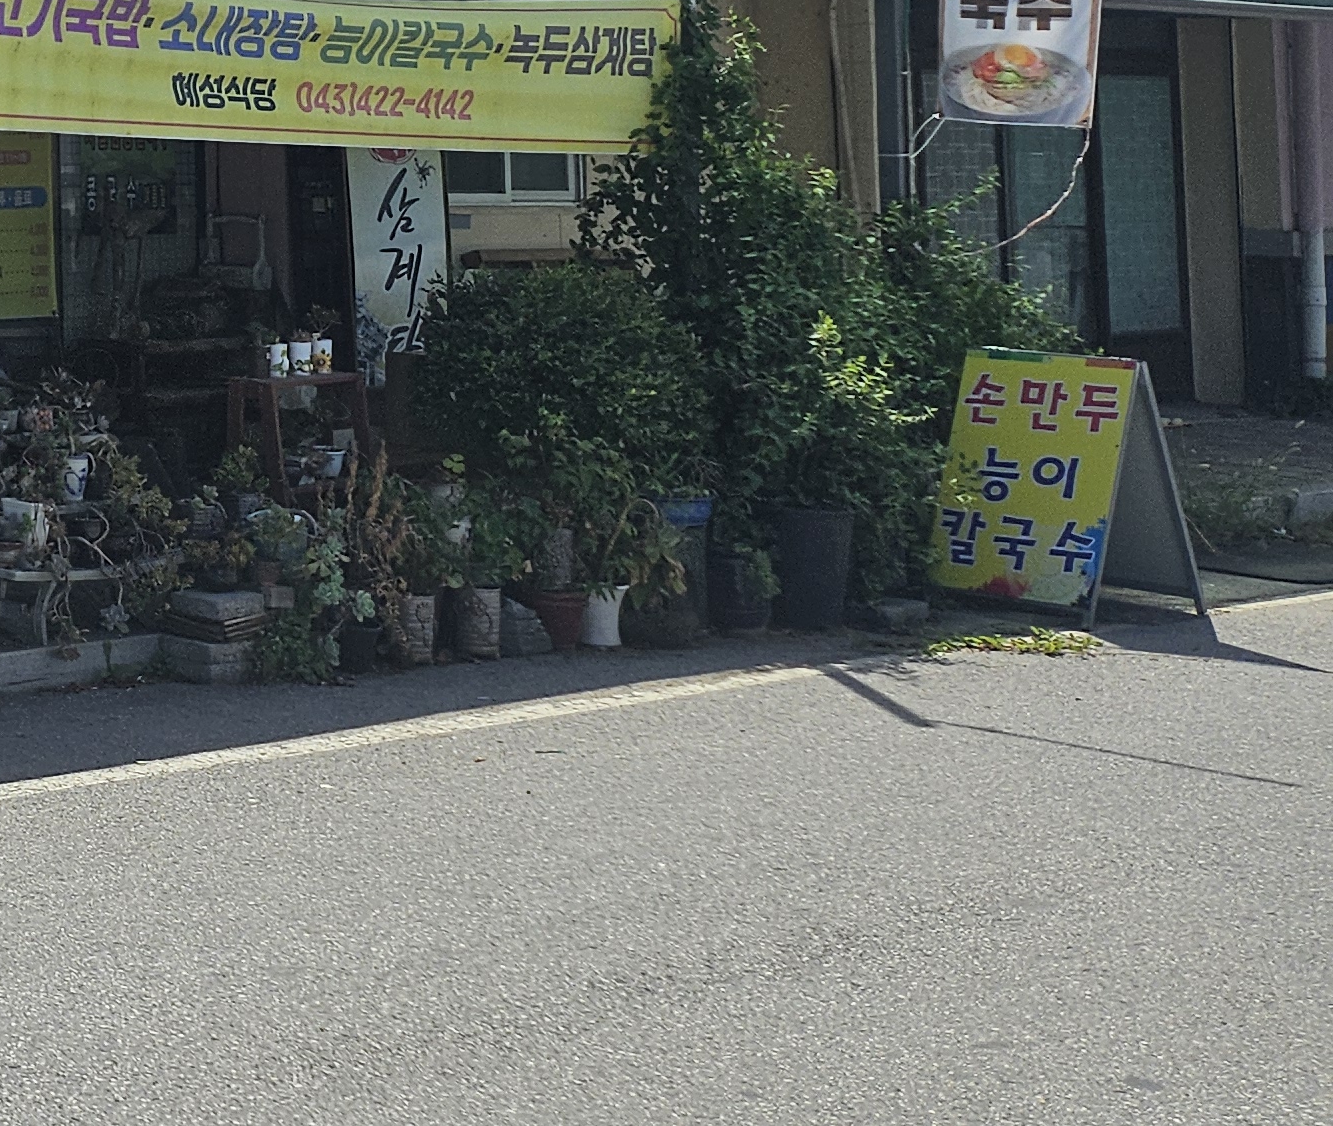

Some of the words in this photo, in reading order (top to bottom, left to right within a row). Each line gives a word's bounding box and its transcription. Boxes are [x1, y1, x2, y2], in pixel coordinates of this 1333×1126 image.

[172, 71, 277, 112] 혜성식당
[295, 81, 474, 121] 043)422-4142
[964, 373, 1119, 432] 손만두
[978, 447, 1079, 502] 능이
[940, 508, 1095, 573] 칼국수
